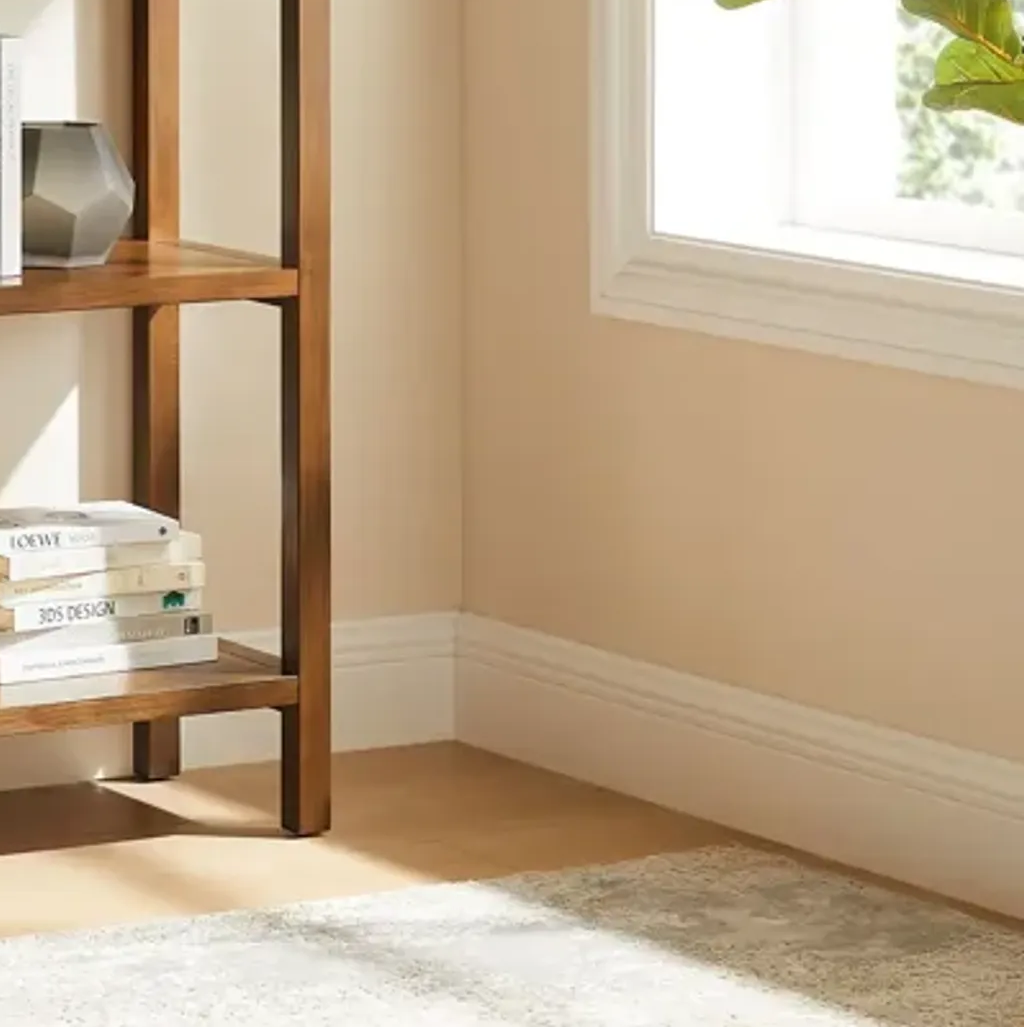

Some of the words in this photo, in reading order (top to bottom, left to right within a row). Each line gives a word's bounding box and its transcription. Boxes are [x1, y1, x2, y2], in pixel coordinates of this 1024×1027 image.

[10, 532, 62, 549] LOEWE
[39, 606, 64, 624] 3DS
[67, 600, 116, 622] DESIGN
